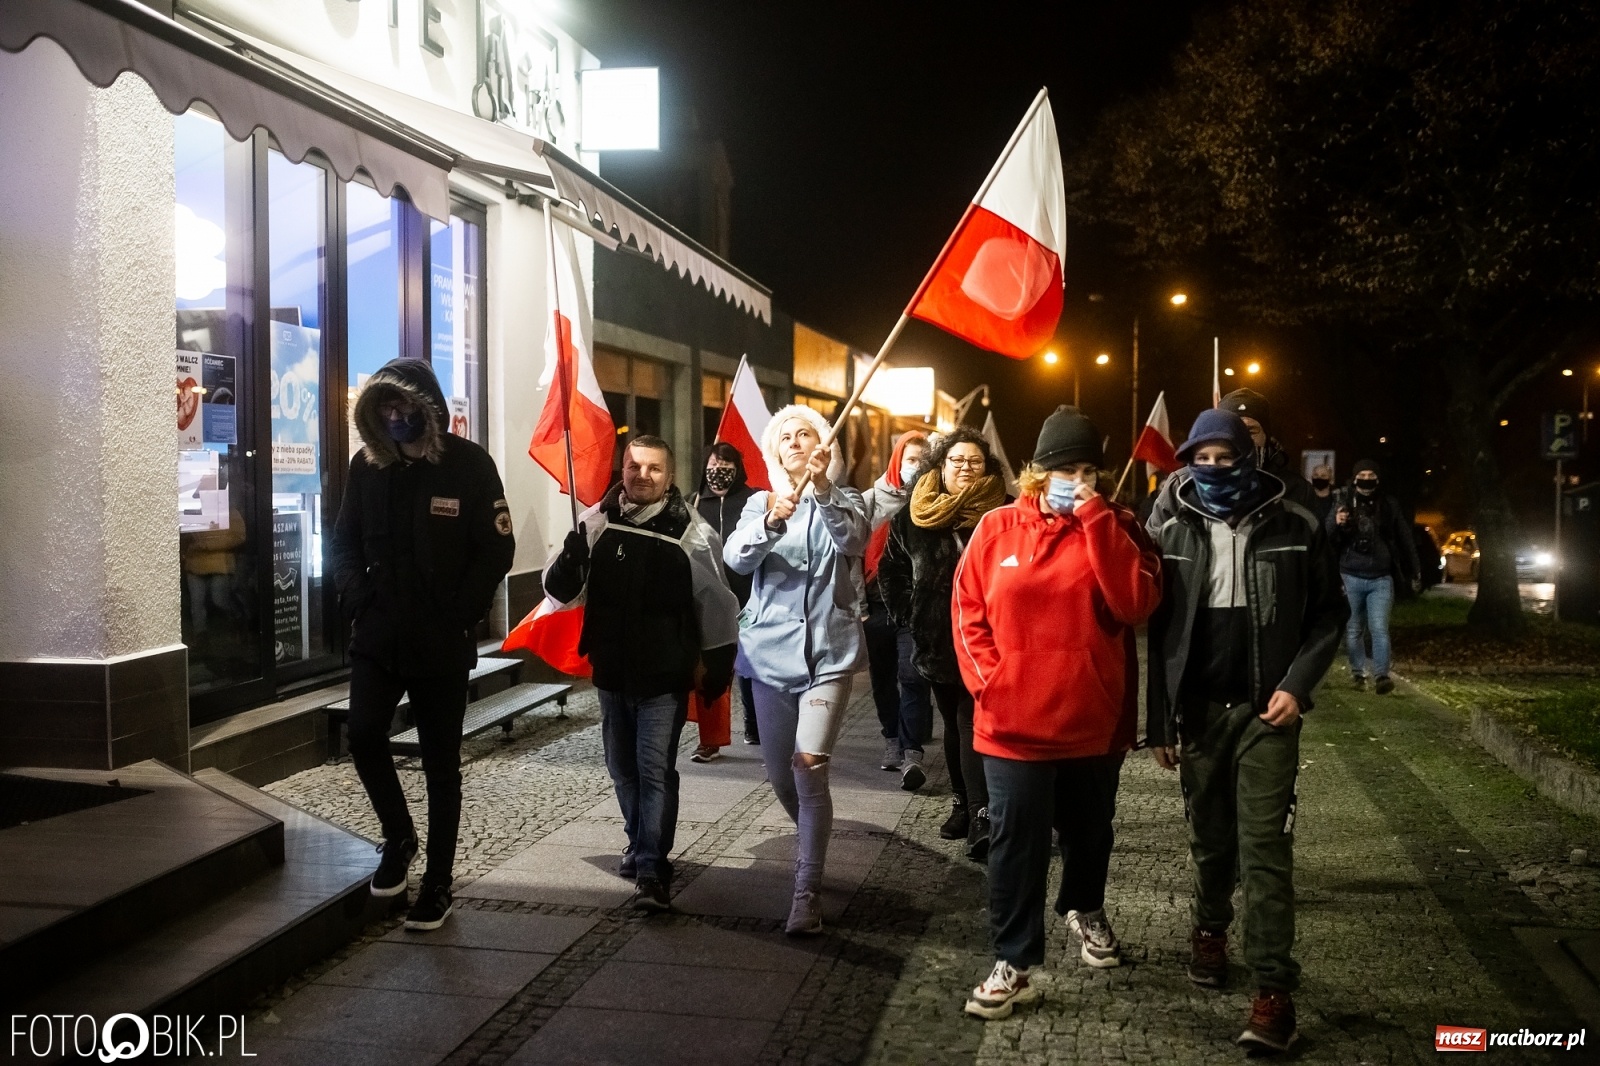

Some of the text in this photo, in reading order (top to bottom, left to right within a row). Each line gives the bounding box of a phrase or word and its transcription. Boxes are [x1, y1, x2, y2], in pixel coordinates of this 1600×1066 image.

[180, 355, 198, 364] WALCZ
[1554, 414, 1571, 435] P
[273, 522, 297, 533] ASZAMY
